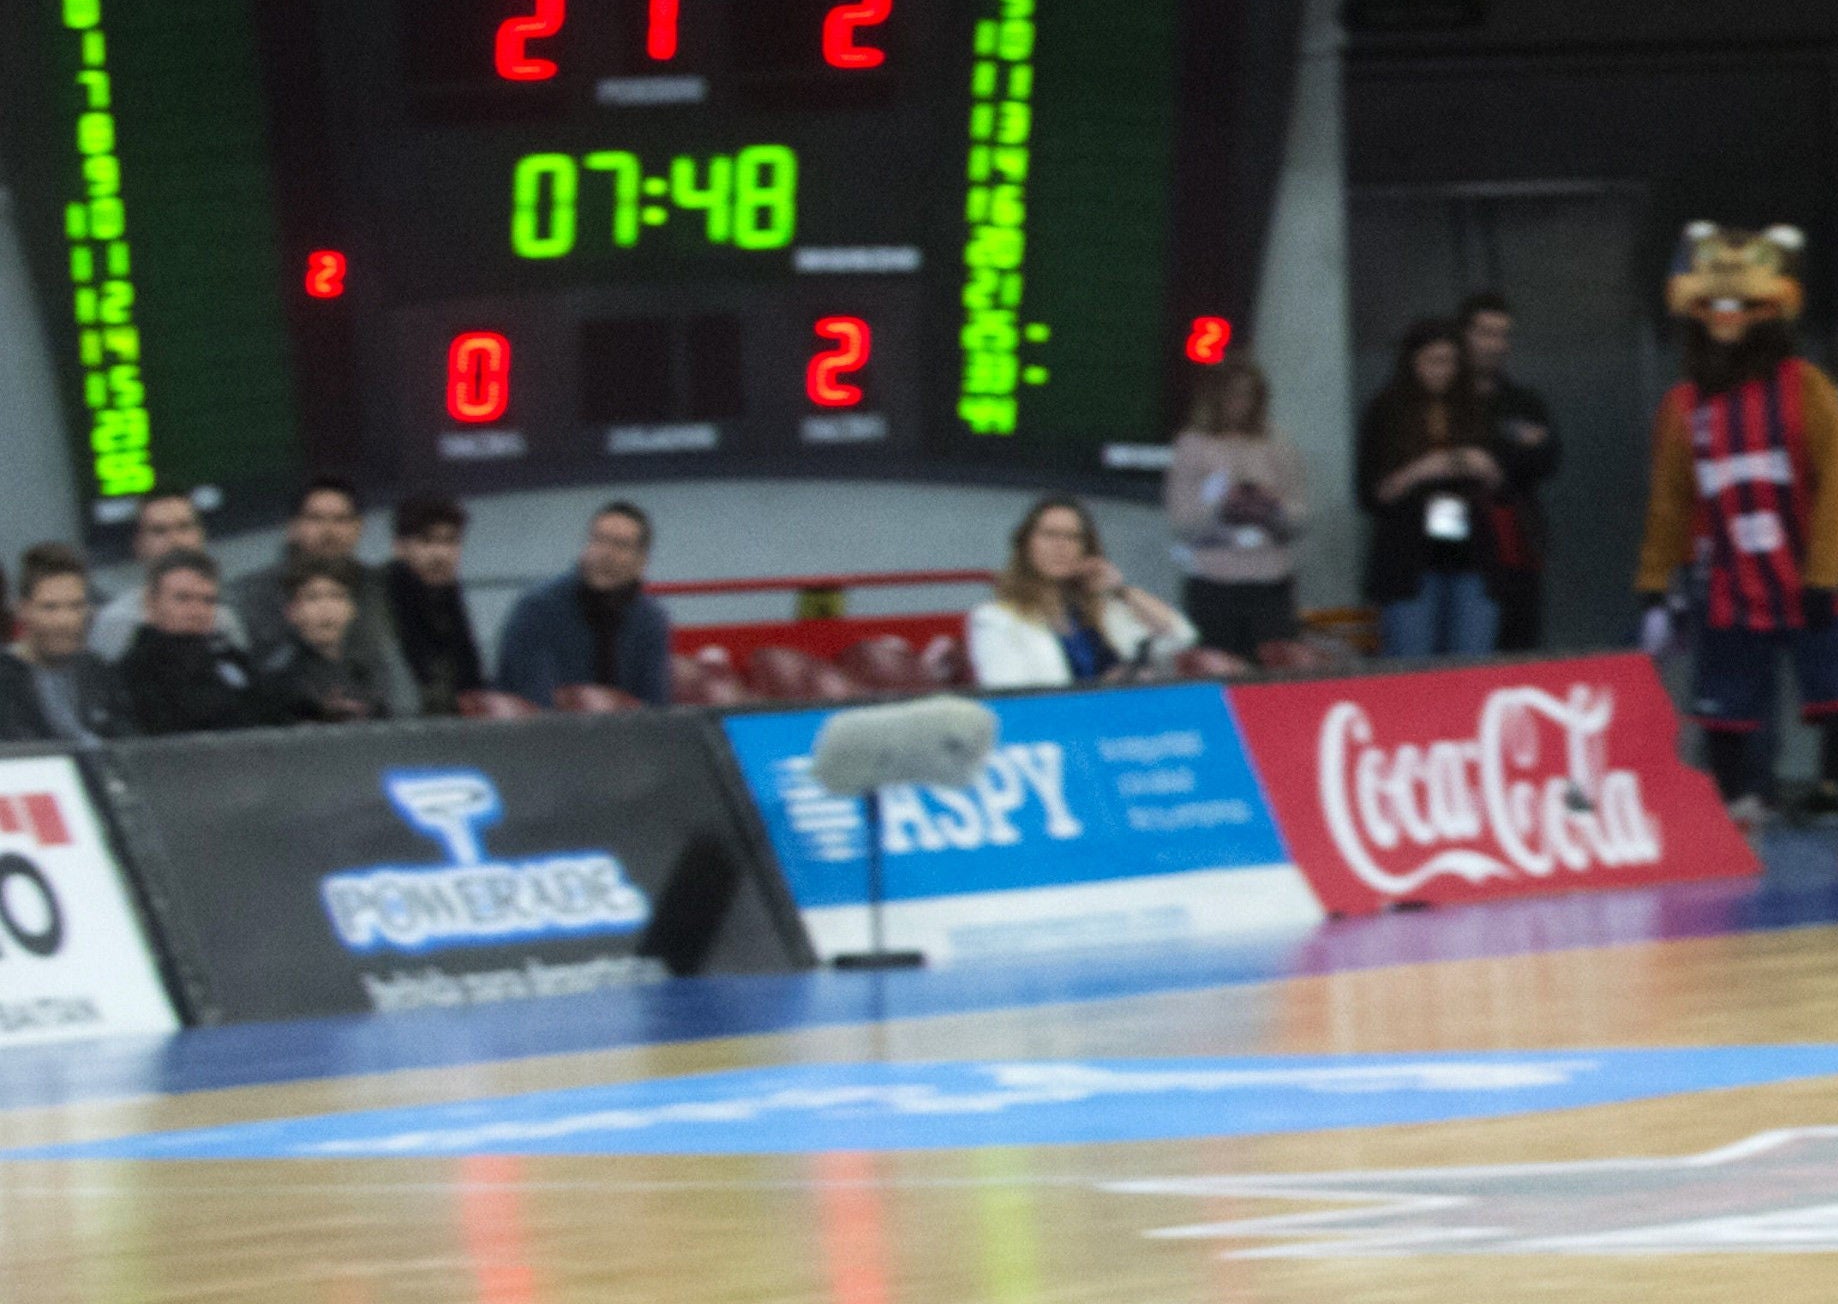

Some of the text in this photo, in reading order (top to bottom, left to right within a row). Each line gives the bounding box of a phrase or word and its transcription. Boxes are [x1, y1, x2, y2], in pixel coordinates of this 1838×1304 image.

[511, 144, 798, 258] 07:48
[446, 330, 511, 424] 0
[806, 315, 872, 407] 2
[882, 741, 1083, 853] ASPY
[324, 856, 646, 950] POWERADE
